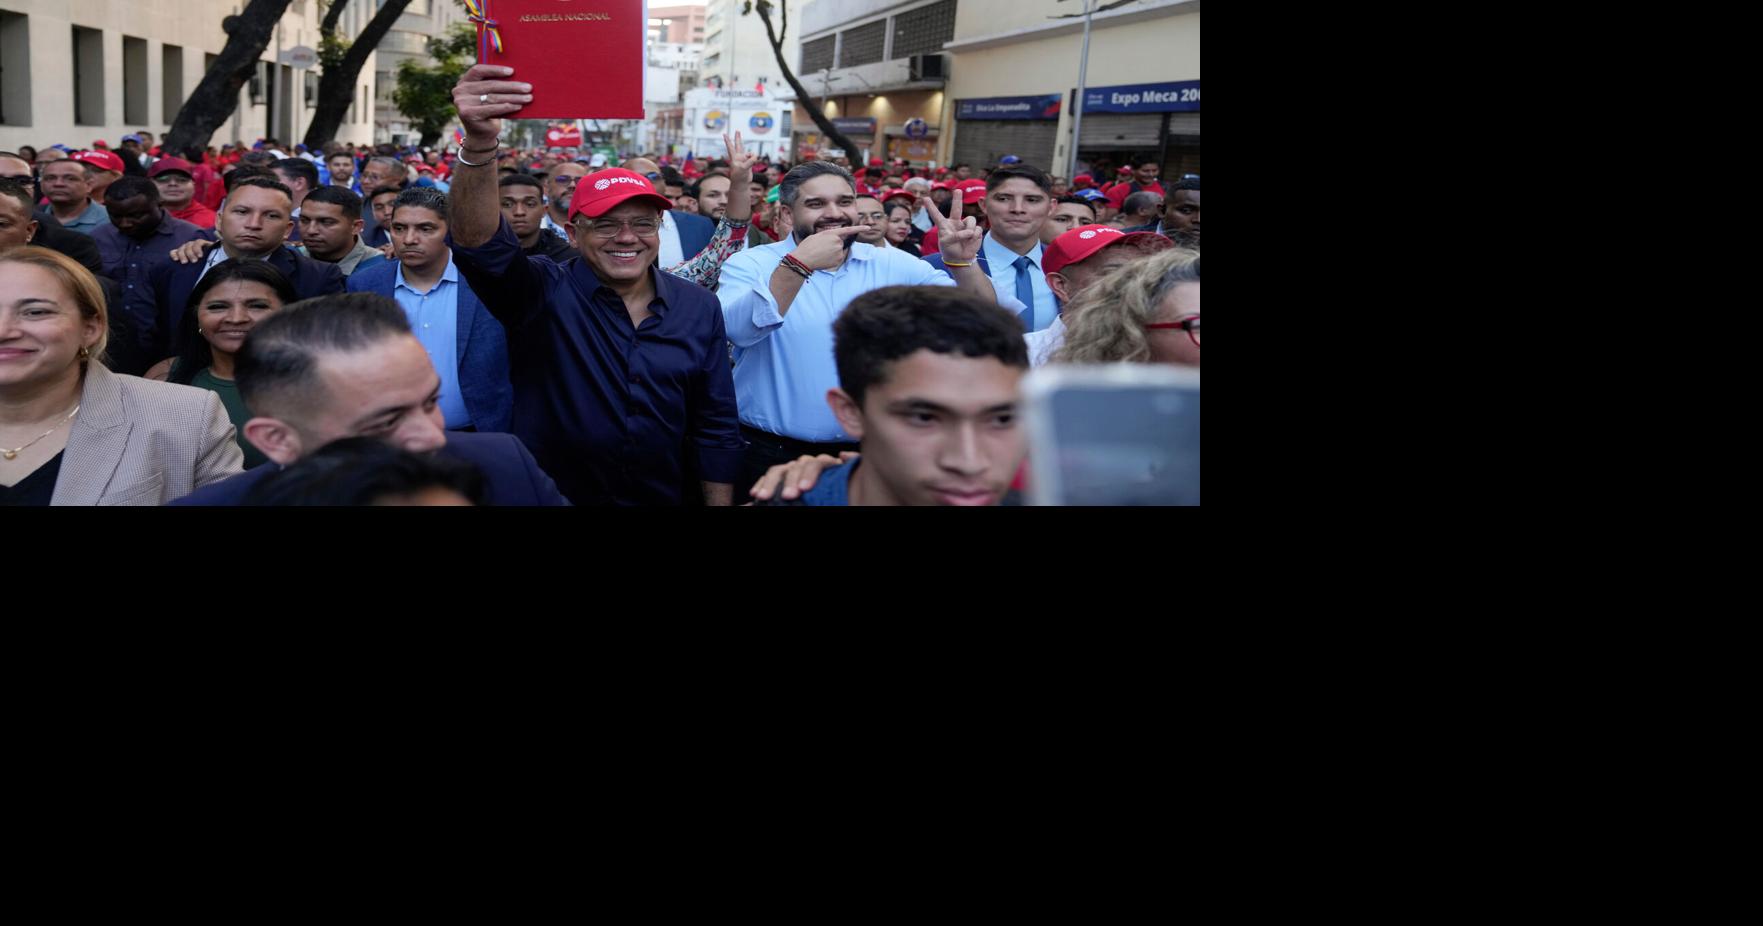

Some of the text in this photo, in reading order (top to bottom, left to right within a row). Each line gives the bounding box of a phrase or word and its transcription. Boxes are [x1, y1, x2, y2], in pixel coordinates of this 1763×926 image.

[519, 12, 611, 22] ASAMBLEA NACIONAL
[1111, 92, 1140, 107] Expo
[1142, 90, 1178, 103] Meca
[610, 176, 647, 187] PDVSA
